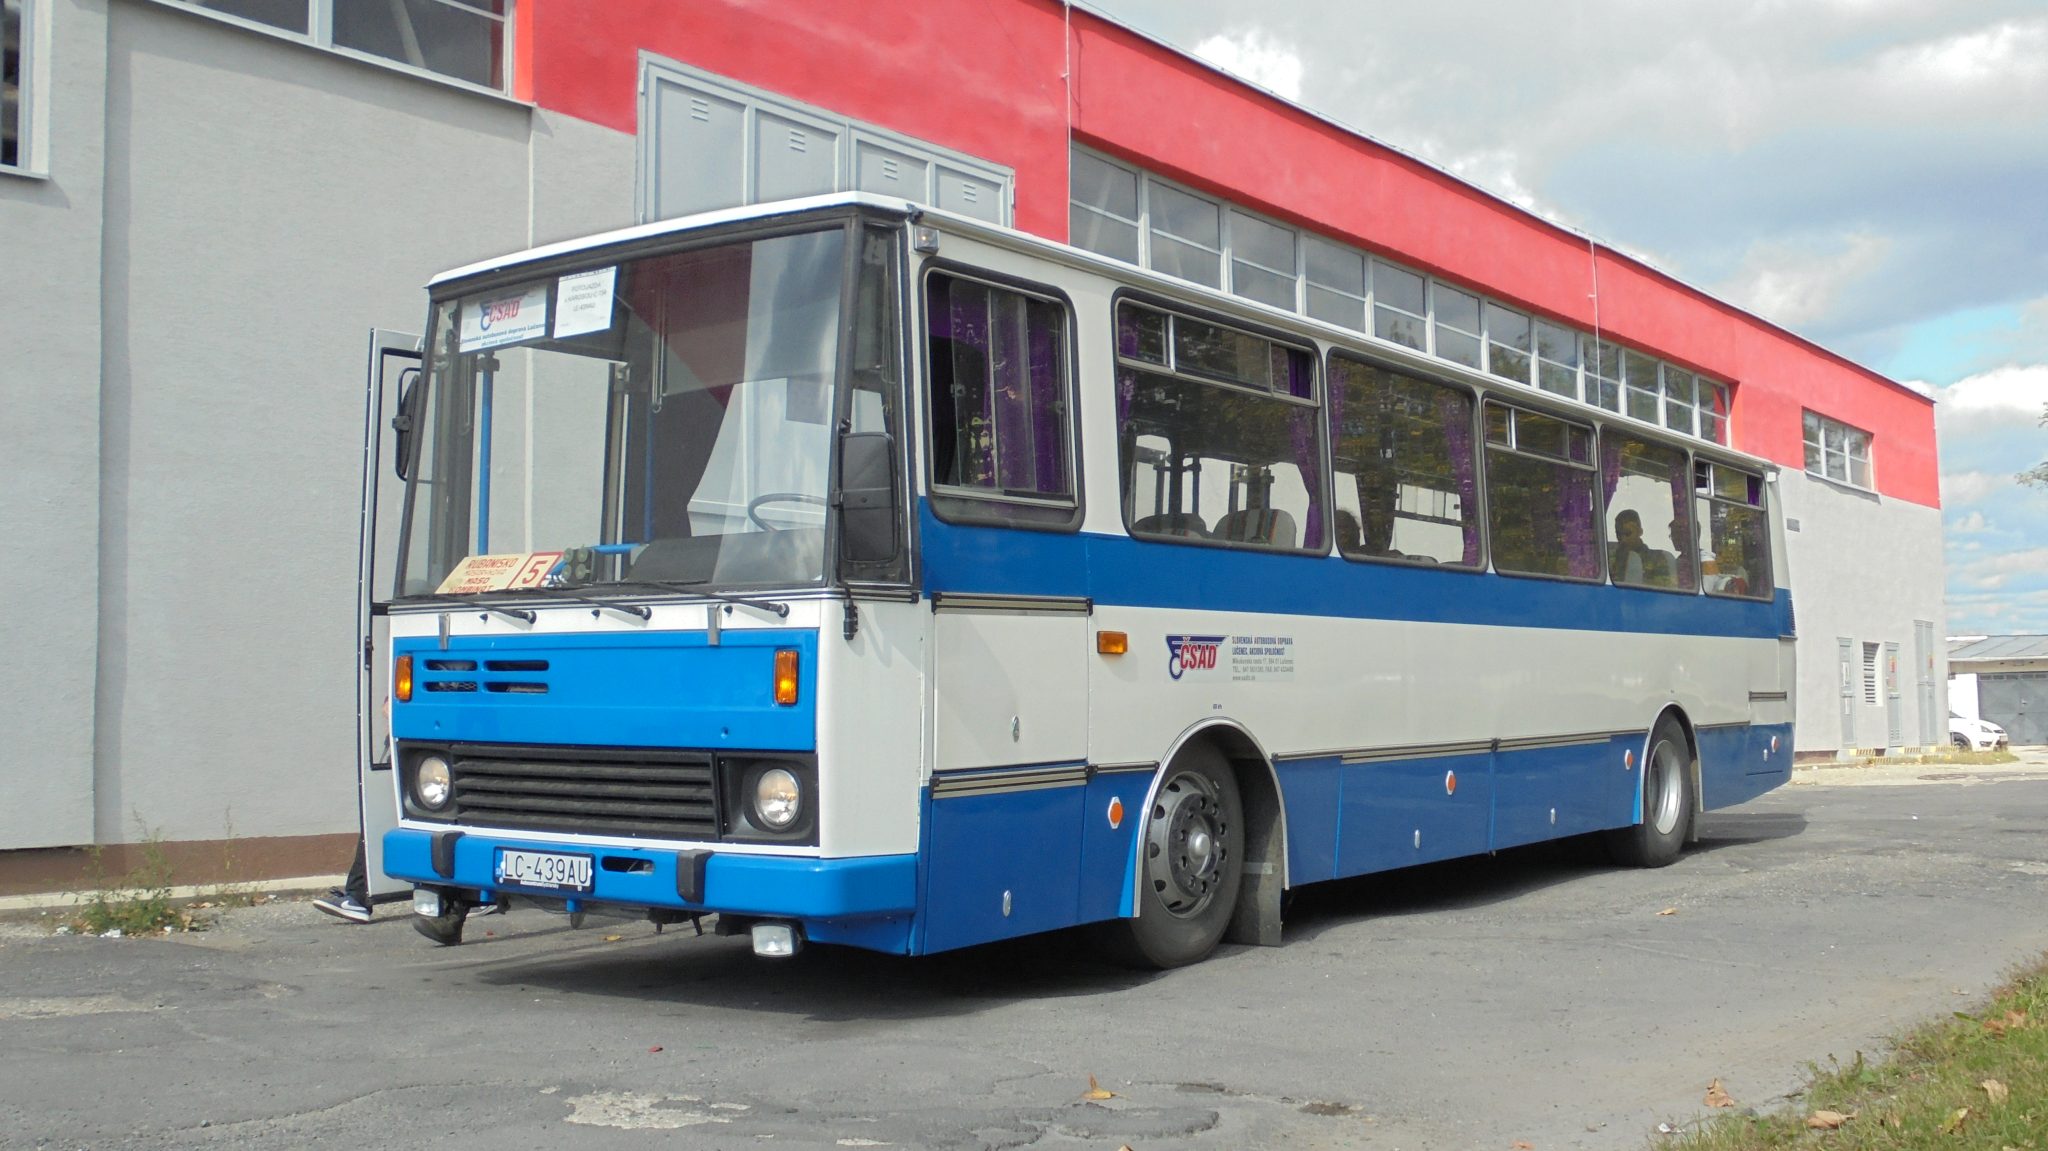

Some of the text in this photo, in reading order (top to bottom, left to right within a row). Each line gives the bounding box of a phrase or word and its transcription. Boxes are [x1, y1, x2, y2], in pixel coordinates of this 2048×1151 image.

[522, 560, 548, 584] 5
[1180, 636, 1217, 669] ČSAD
[504, 854, 589, 885] LC-439AU
